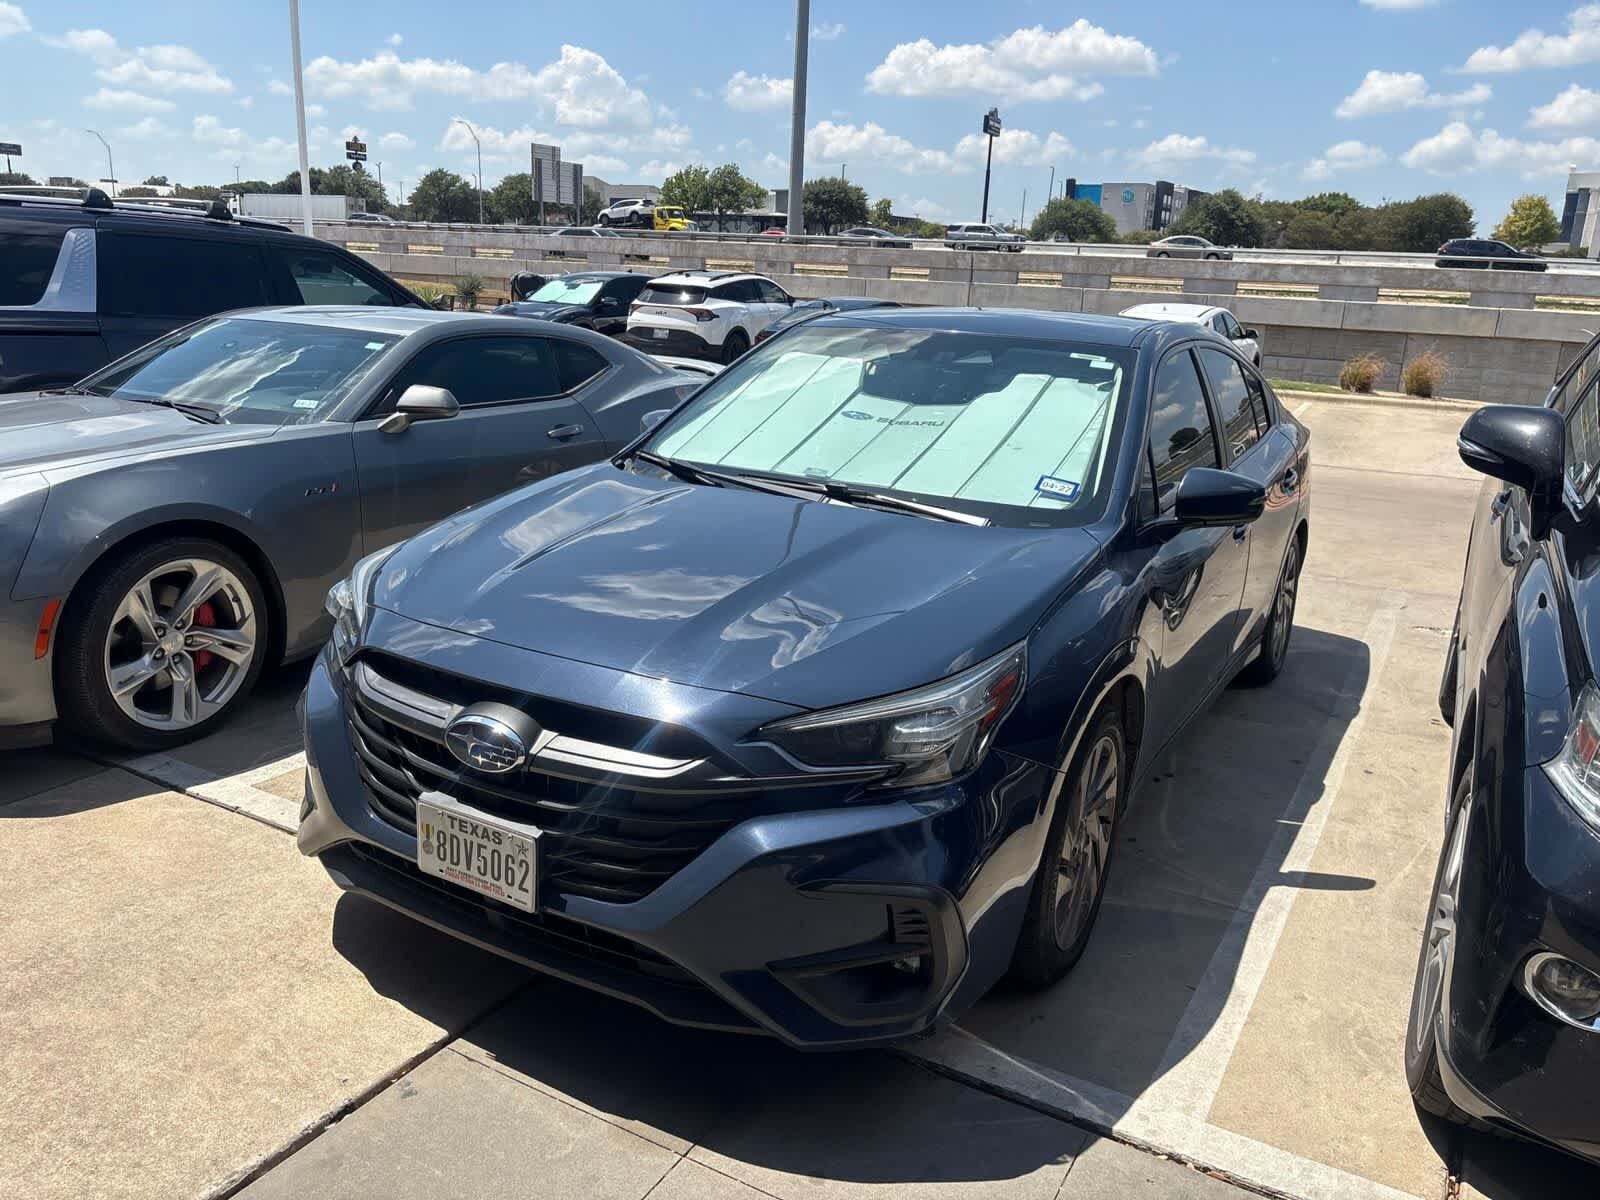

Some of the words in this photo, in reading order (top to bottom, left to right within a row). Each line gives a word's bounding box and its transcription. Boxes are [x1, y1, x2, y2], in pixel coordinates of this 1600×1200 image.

[876, 417, 945, 427] SUBARU
[448, 815, 503, 846] TEXAS
[436, 830, 530, 894] 8DV5062
